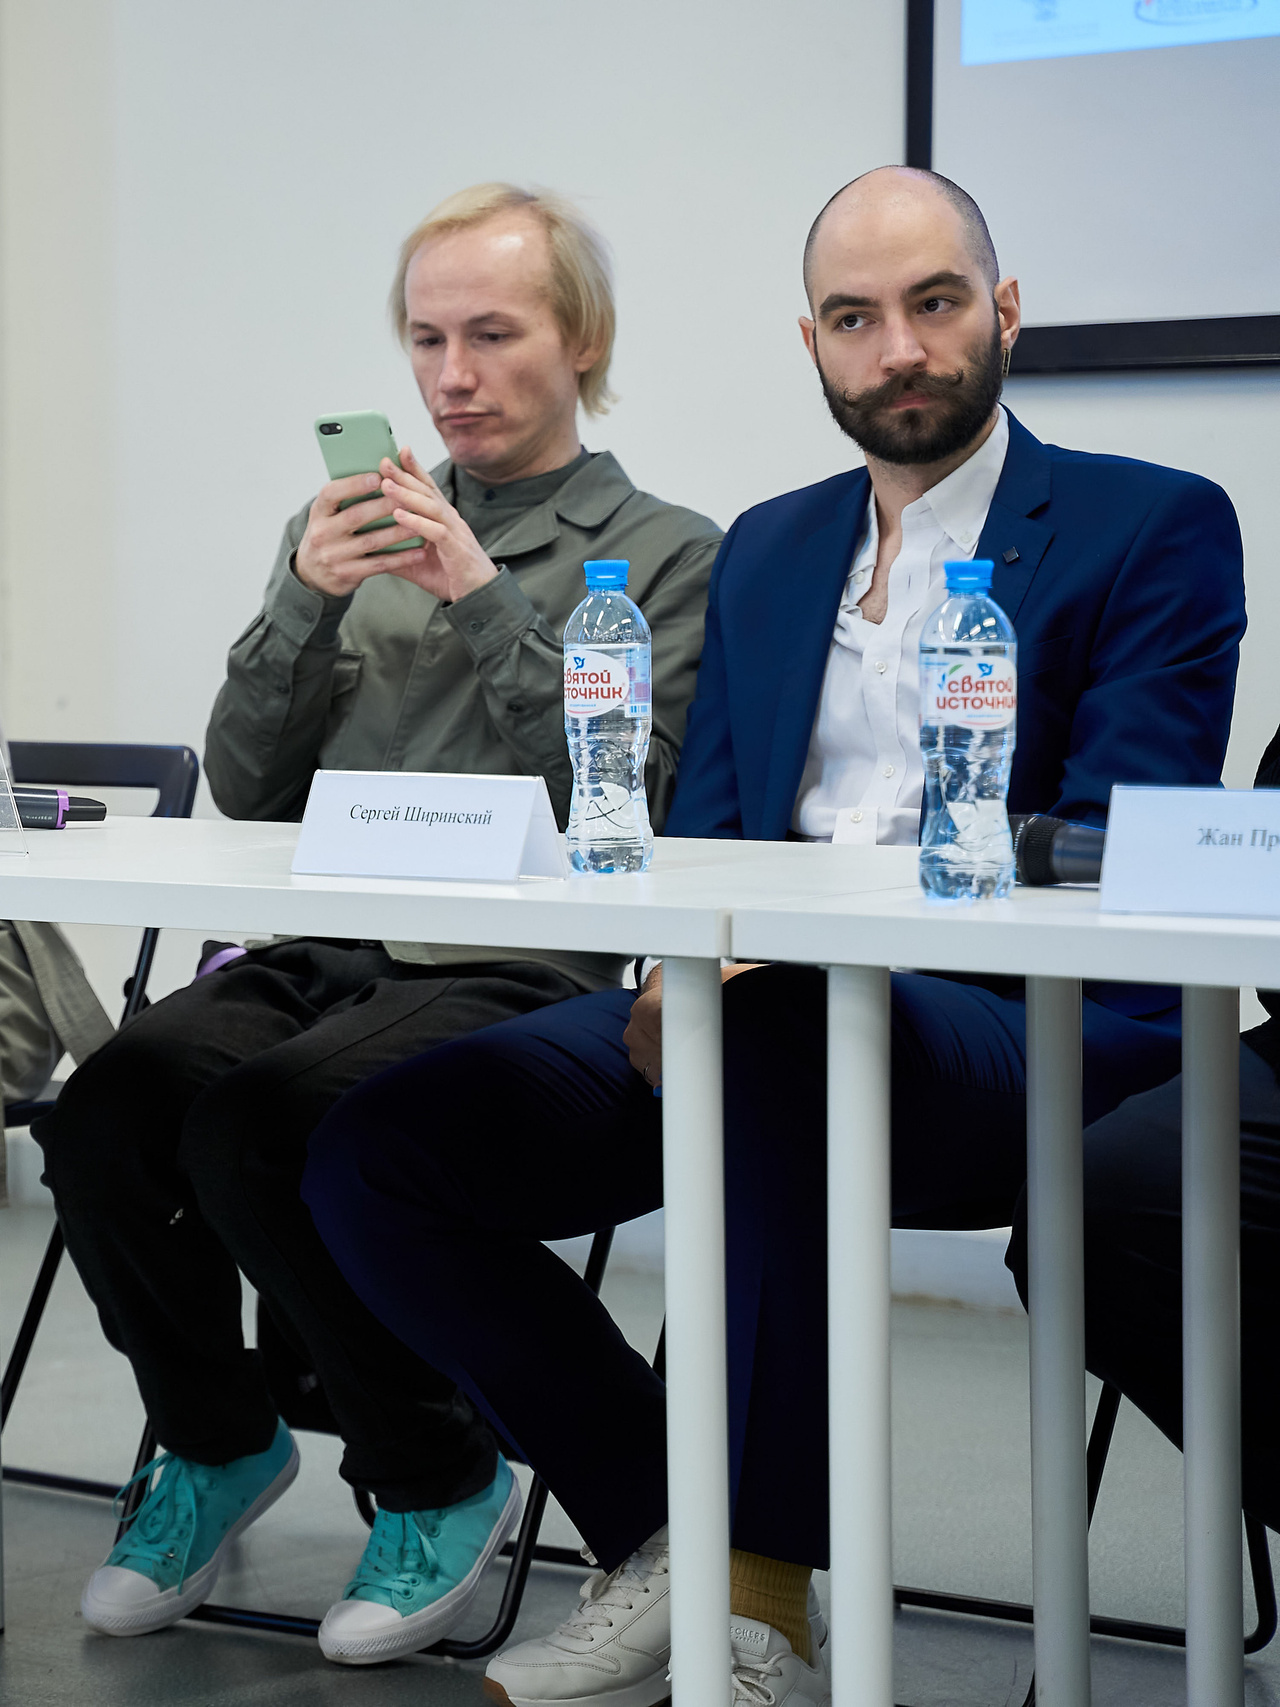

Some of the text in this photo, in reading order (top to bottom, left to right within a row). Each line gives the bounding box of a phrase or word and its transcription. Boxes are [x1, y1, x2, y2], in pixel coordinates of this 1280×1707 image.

[349, 804, 493, 827] Сергей Ширинский
[1196, 828, 1244, 846] Жан
